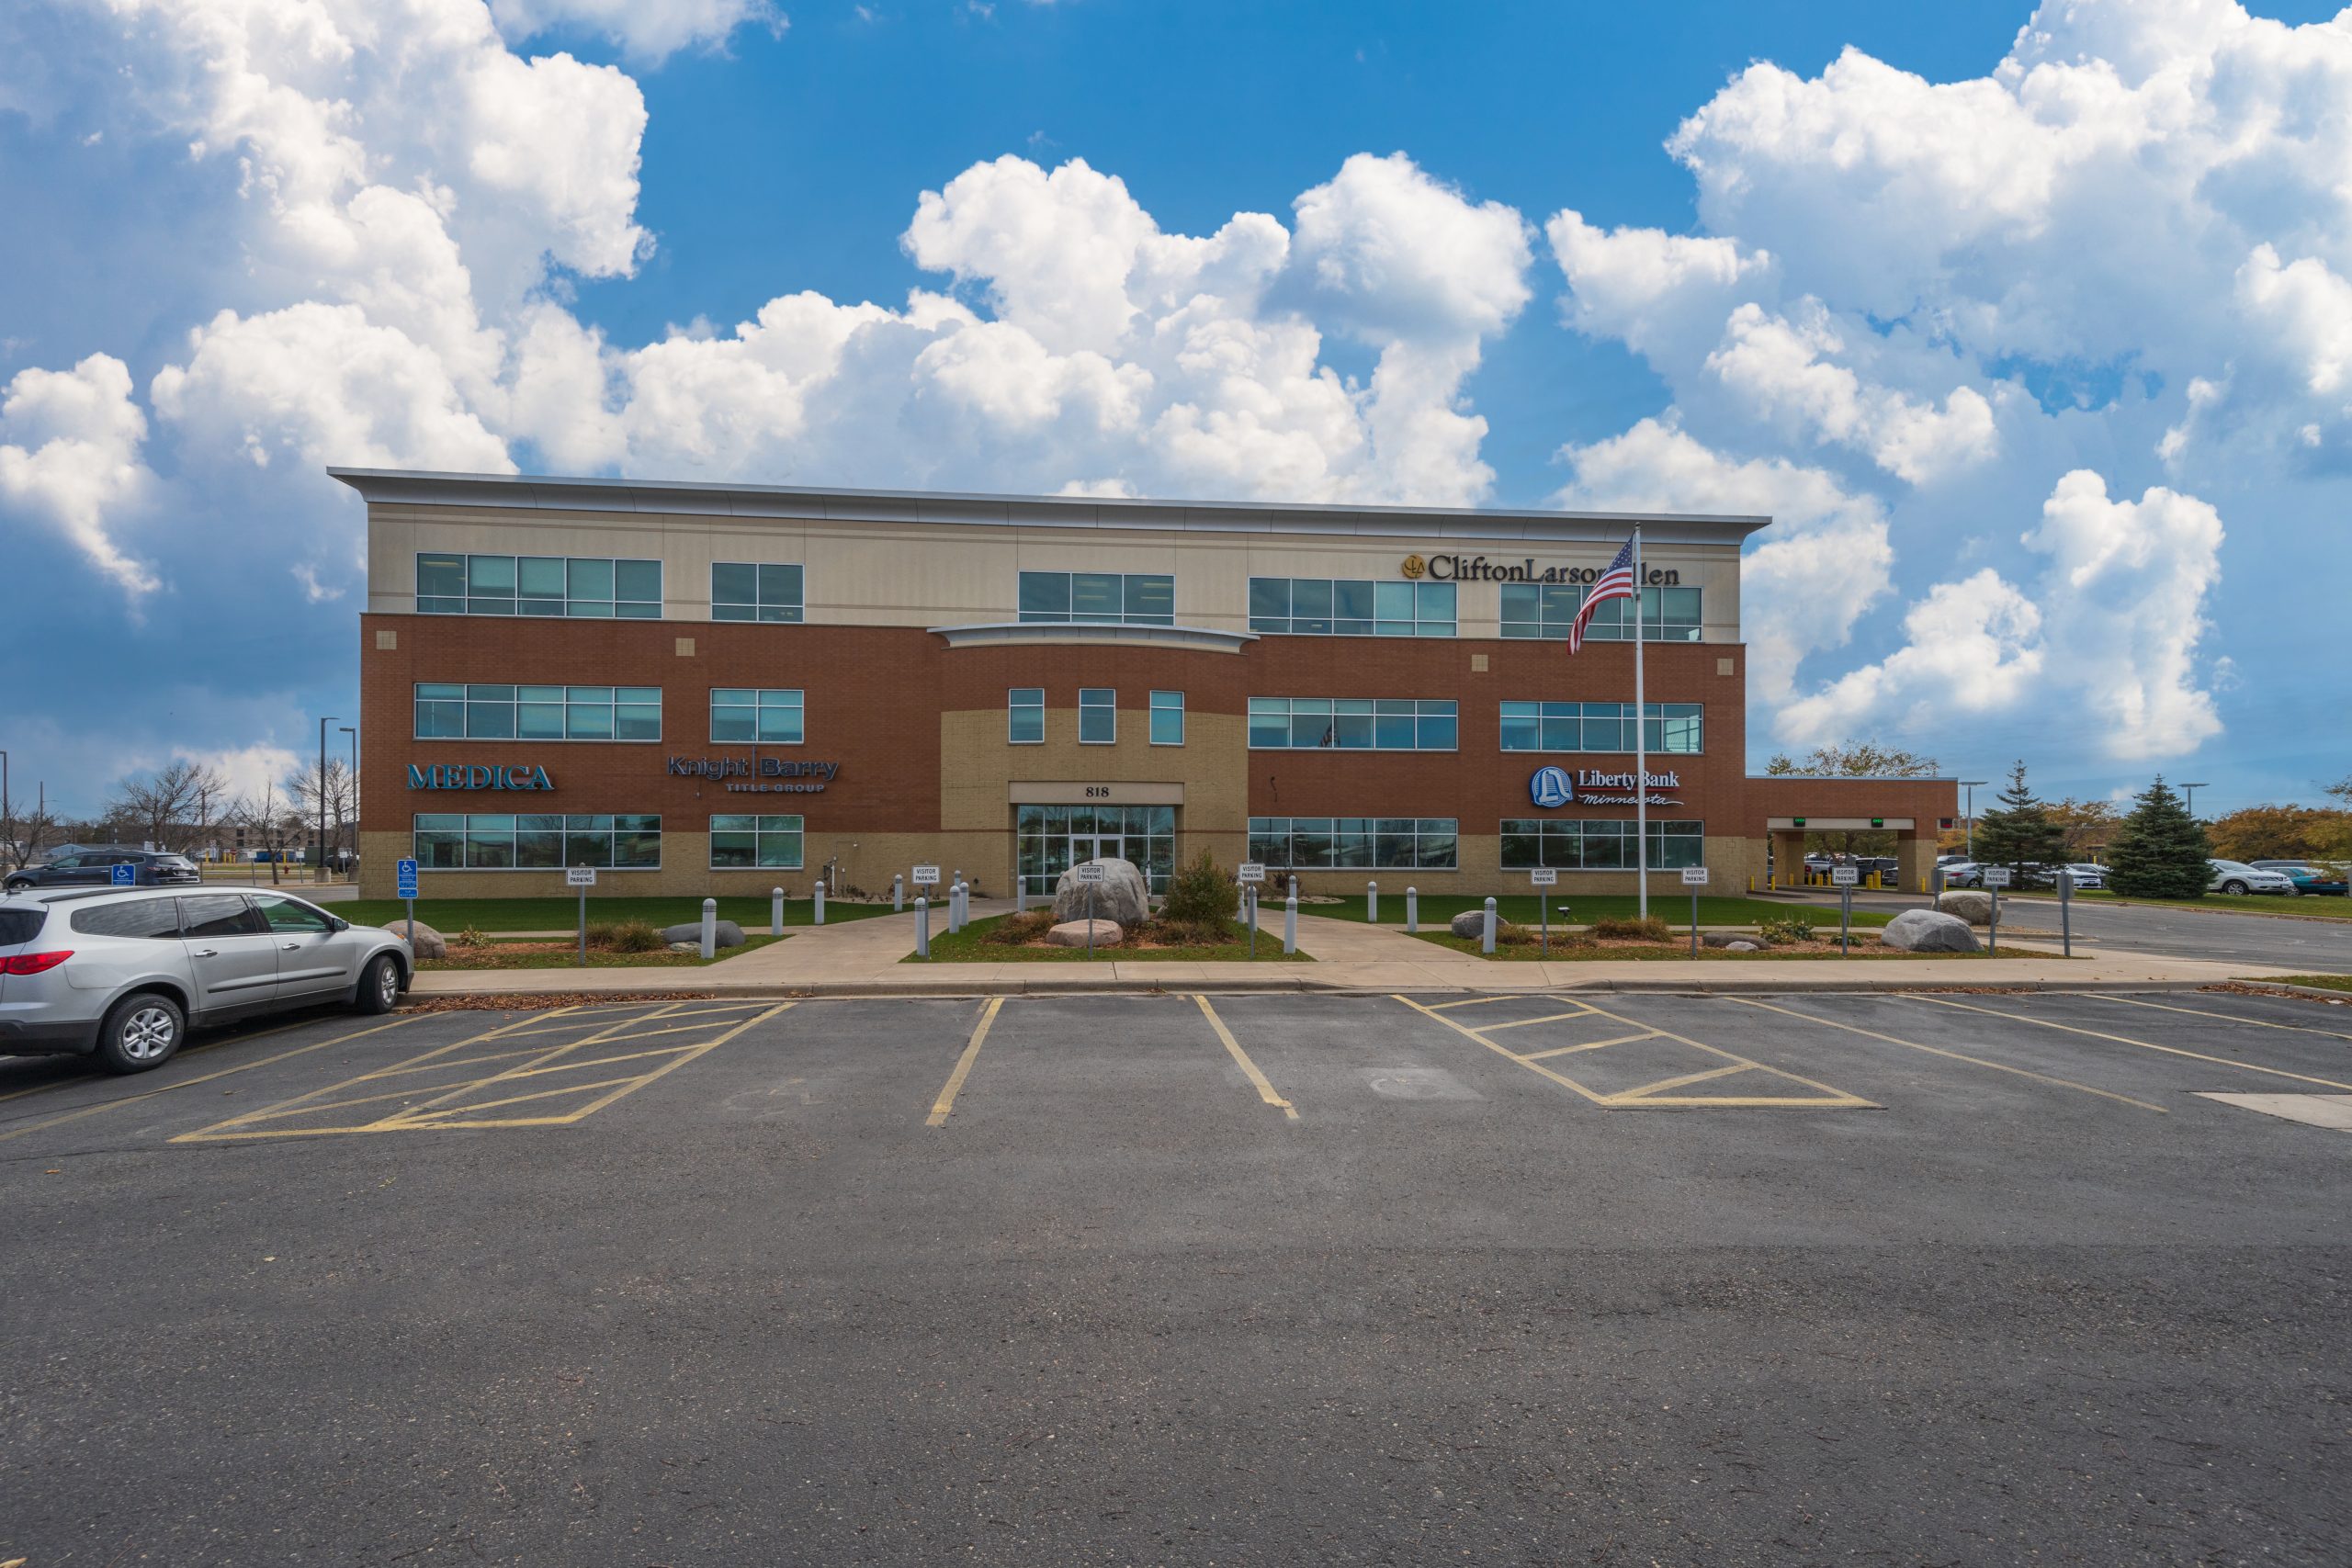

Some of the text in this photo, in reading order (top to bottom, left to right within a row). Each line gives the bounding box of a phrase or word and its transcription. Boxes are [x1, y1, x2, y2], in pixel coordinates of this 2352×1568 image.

[1429, 555, 1679, 585] CliftonLarsollen
[406, 764, 555, 790] MEDICA
[668, 757, 839, 781] Knight Barry
[726, 784, 825, 793] TITLE GROUP
[1086, 786, 1109, 797] 818
